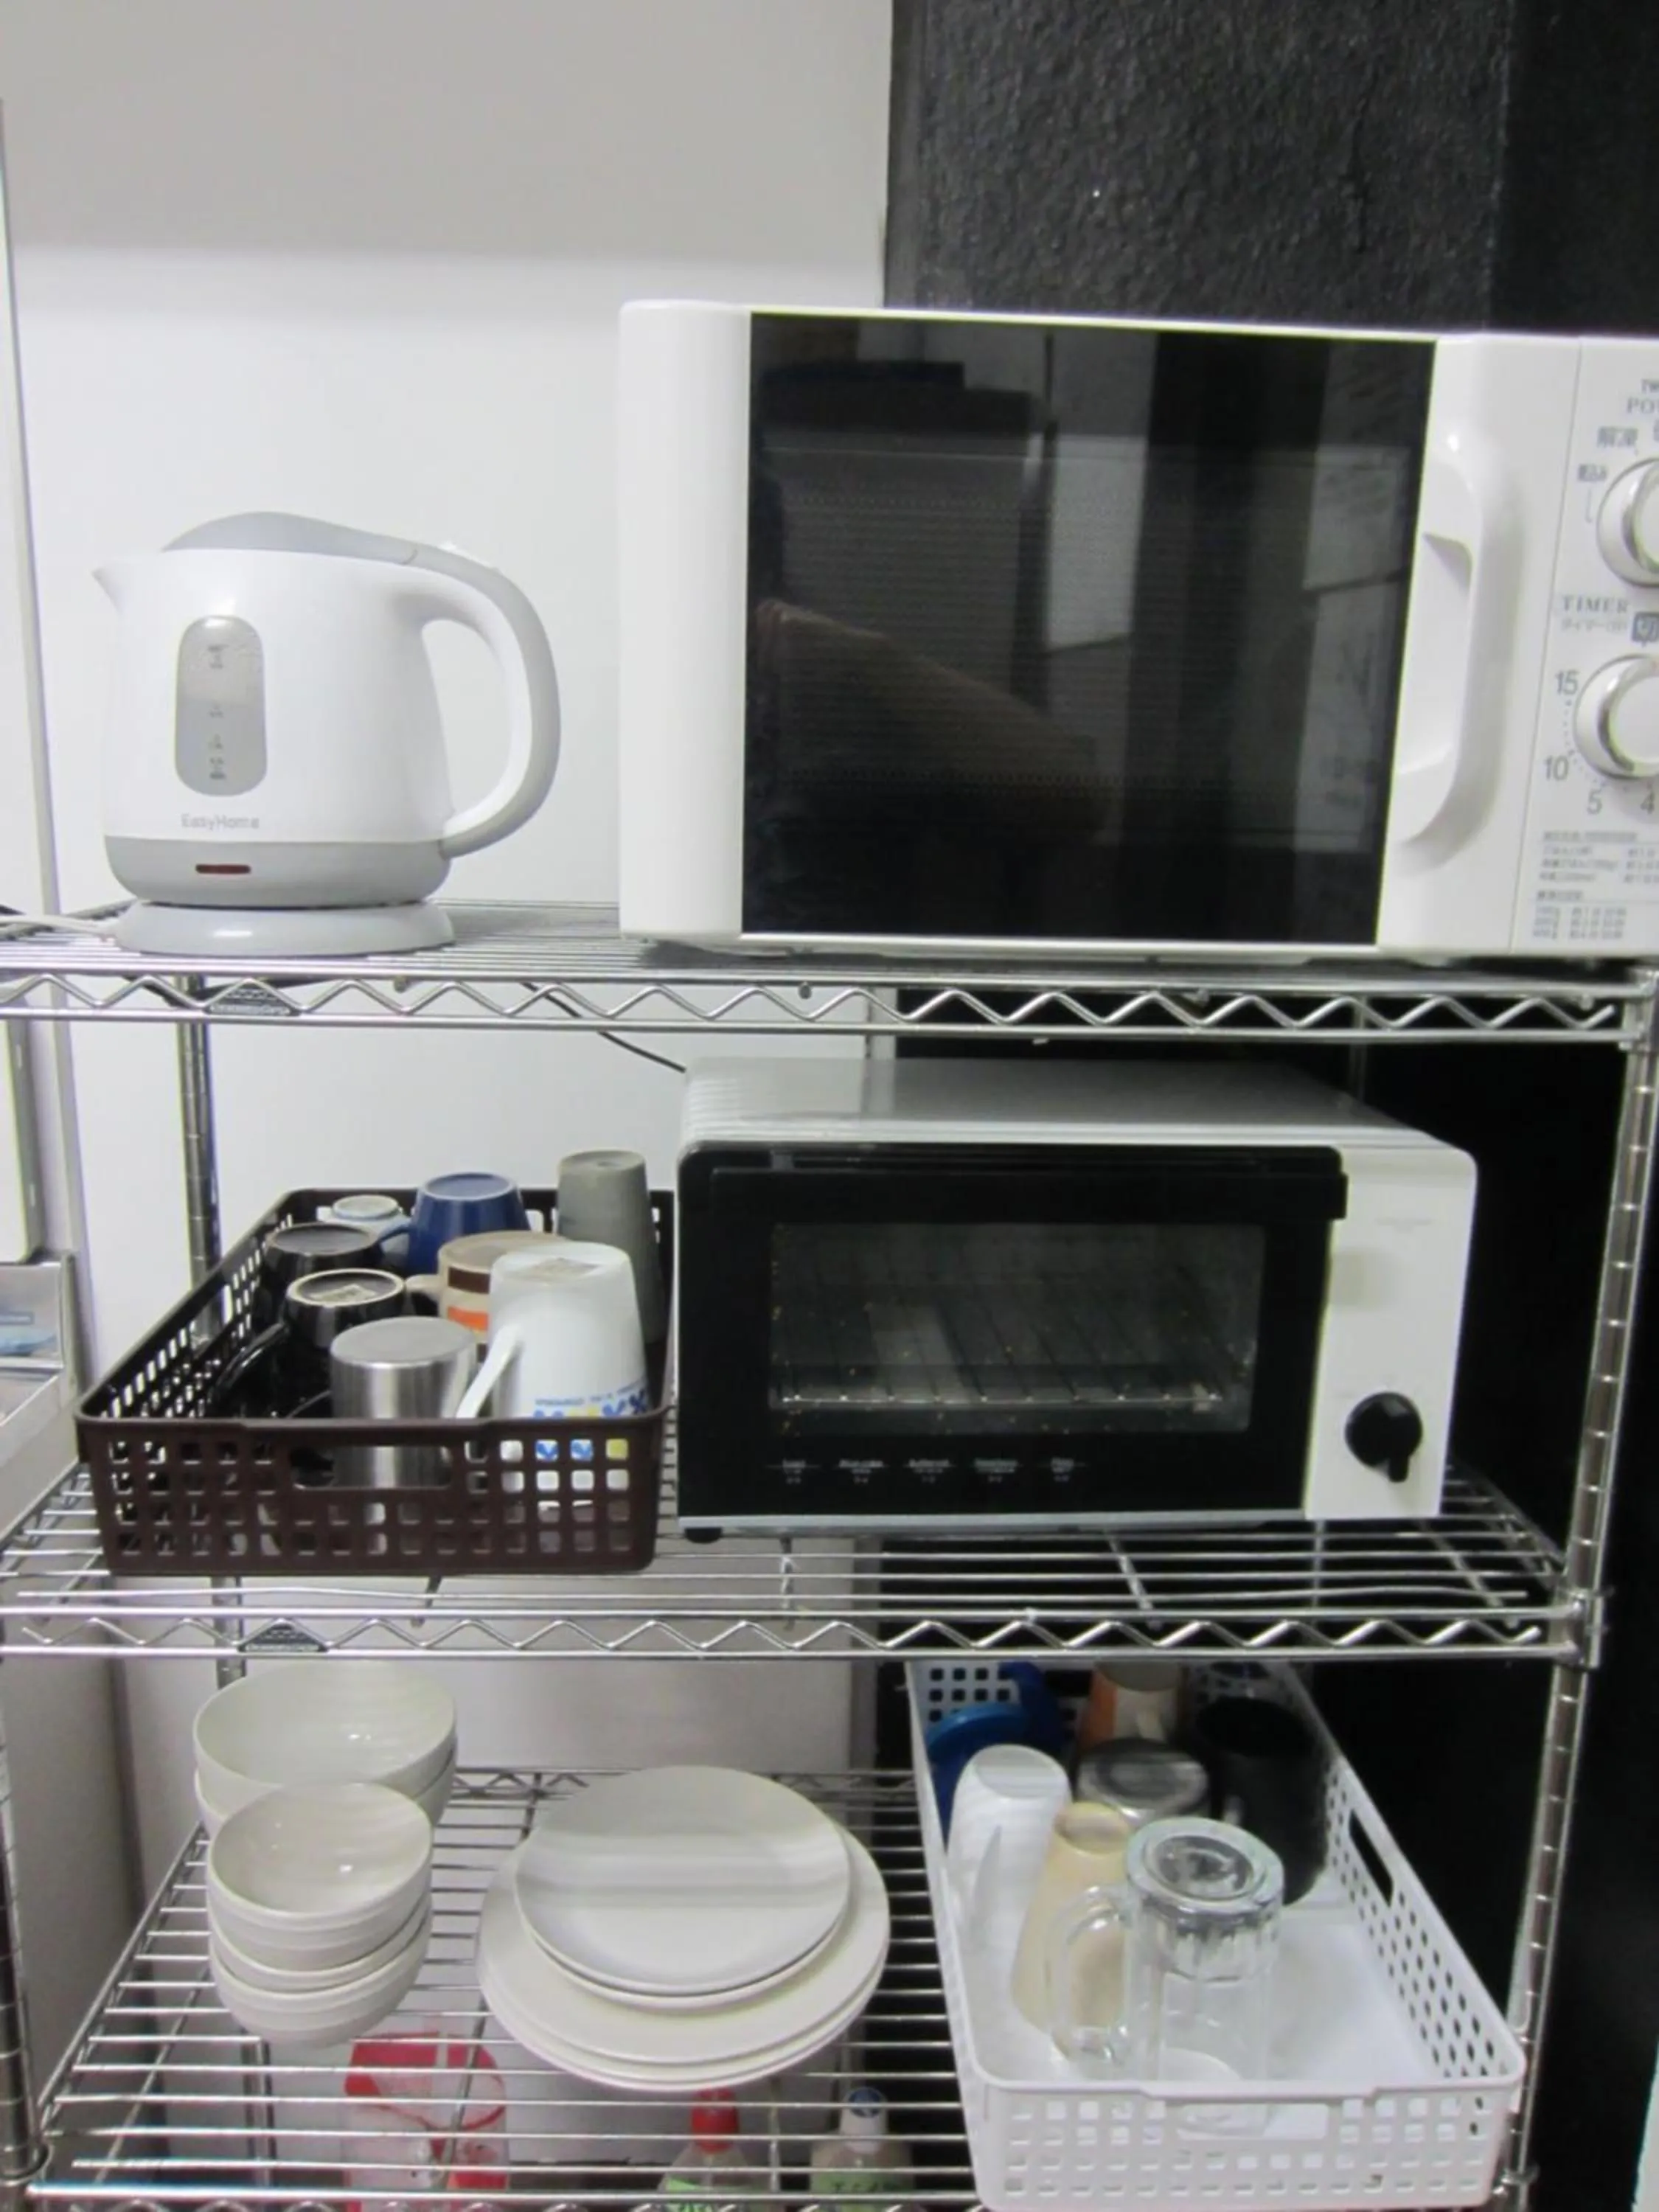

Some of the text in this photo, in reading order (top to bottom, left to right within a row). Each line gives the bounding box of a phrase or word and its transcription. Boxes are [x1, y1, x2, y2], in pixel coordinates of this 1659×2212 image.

[1562, 594, 1628, 614] TIMER
[1555, 669, 1579, 695] 15
[1544, 755, 1569, 781] 10
[1586, 789, 1603, 815] 5
[1640, 790, 1655, 815] 4
[181, 812, 260, 831] EasyHome
